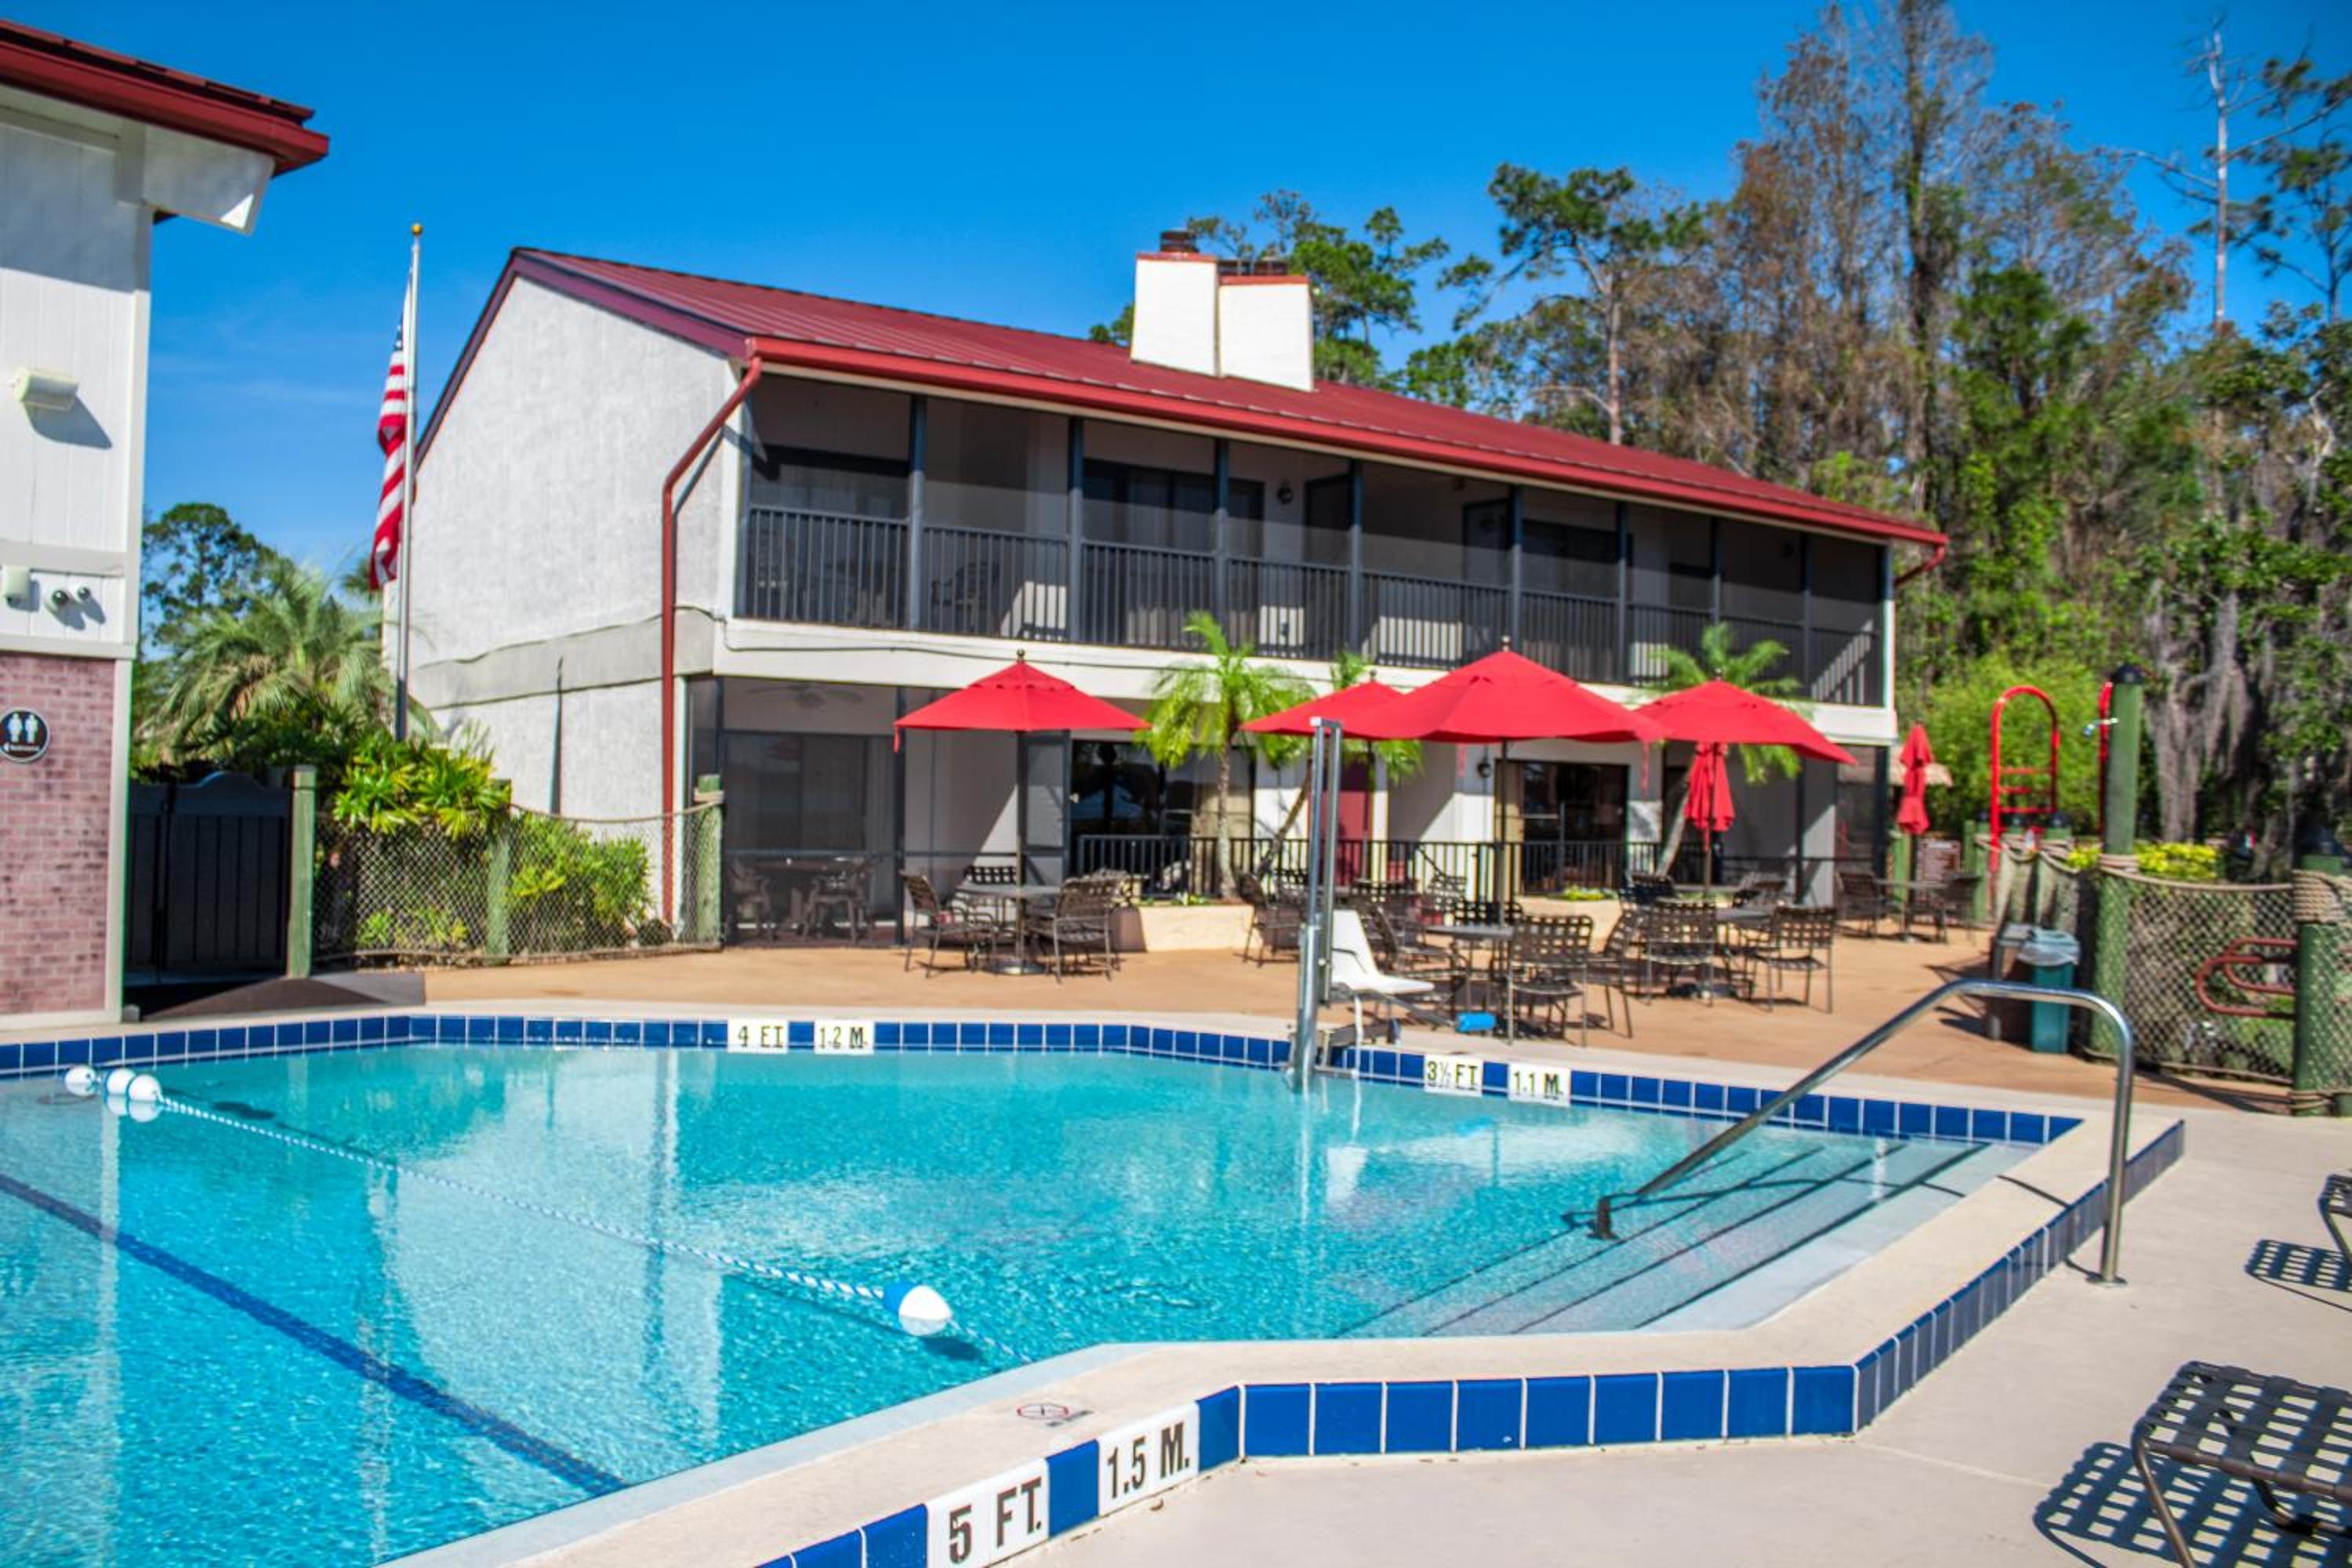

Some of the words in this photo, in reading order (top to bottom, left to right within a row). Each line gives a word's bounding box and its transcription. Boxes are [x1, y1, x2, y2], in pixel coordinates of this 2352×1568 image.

[738, 1025, 749, 1046] 4
[819, 1026, 842, 1048] 1.2
[849, 1026, 868, 1048] M.
[1514, 1070, 1535, 1094] 1.1
[1107, 1436, 1146, 1499] 1.5
[1160, 1421, 1190, 1479] M.
[949, 1504, 973, 1564] 5
[996, 1475, 1042, 1548] FT.
